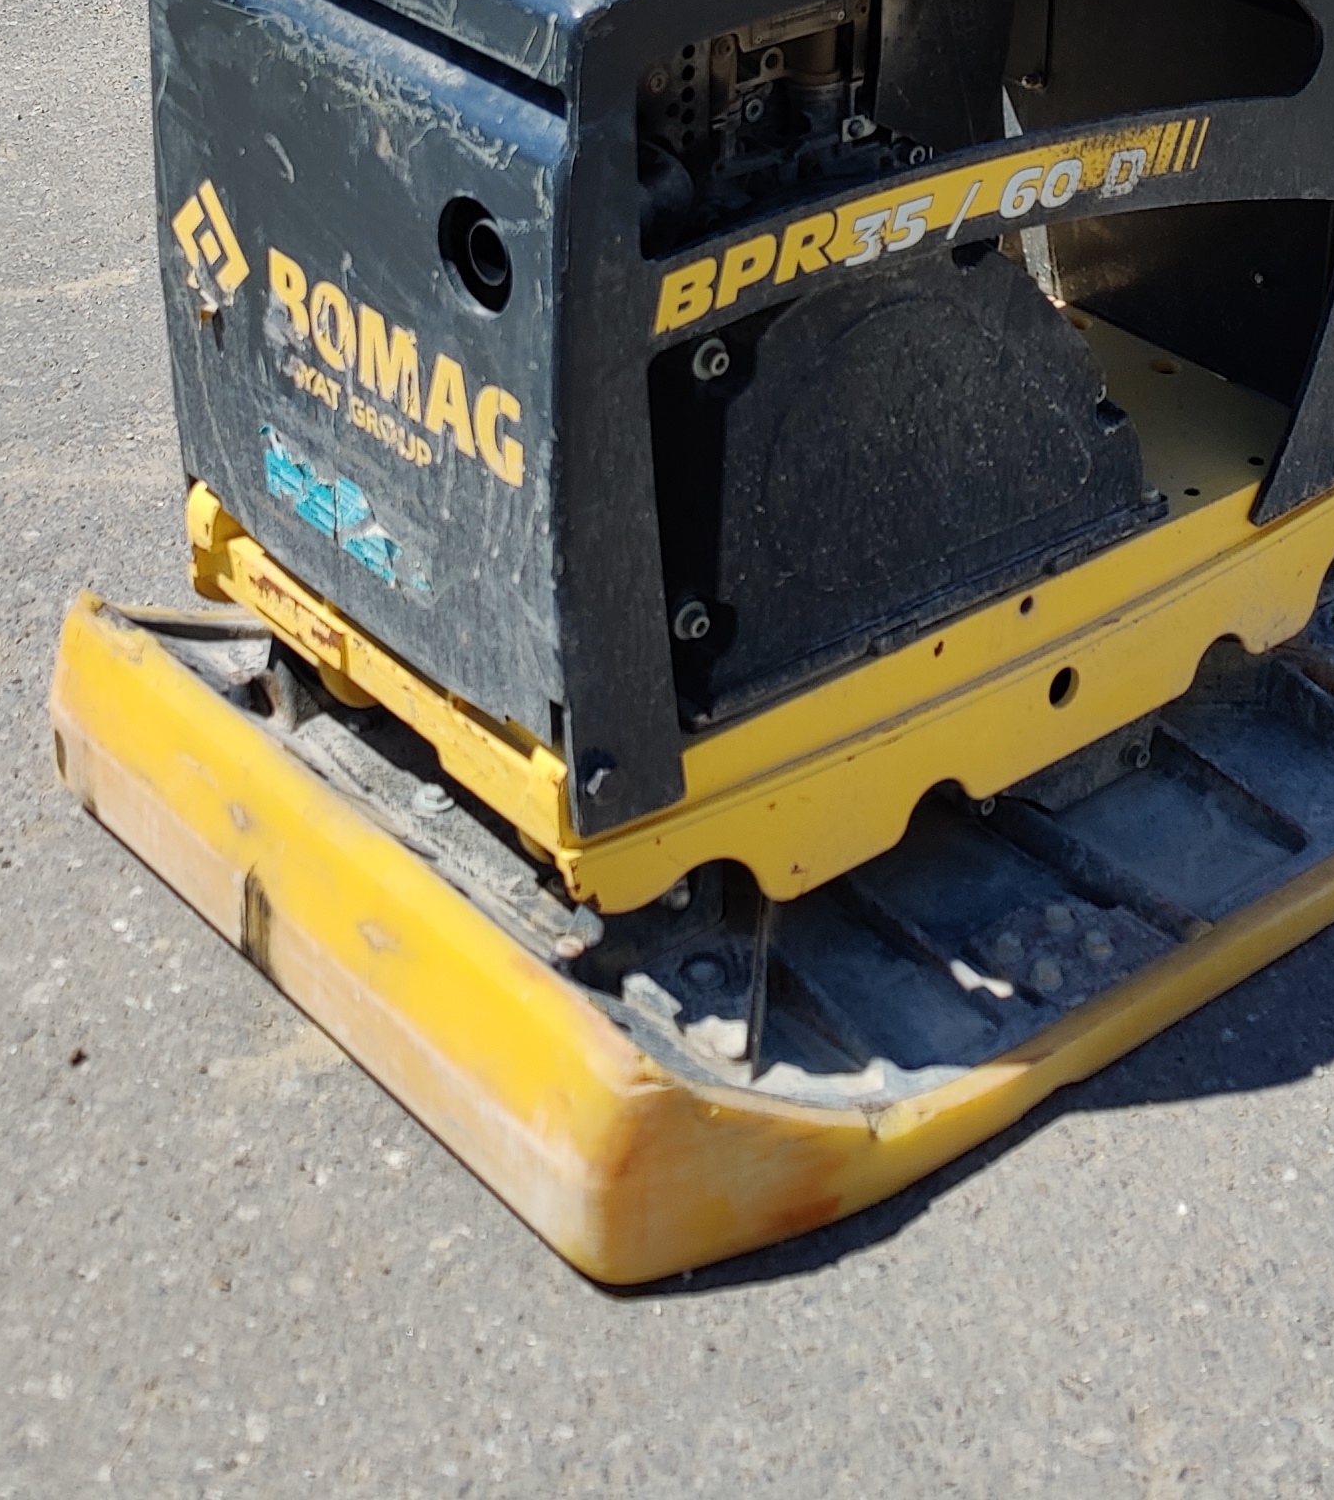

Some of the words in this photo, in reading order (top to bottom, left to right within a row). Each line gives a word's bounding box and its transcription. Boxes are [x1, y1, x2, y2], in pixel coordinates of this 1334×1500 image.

[998, 158, 1083, 219] 60
[1099, 148, 1147, 200] D
[349, 394, 433, 468] GROUP
